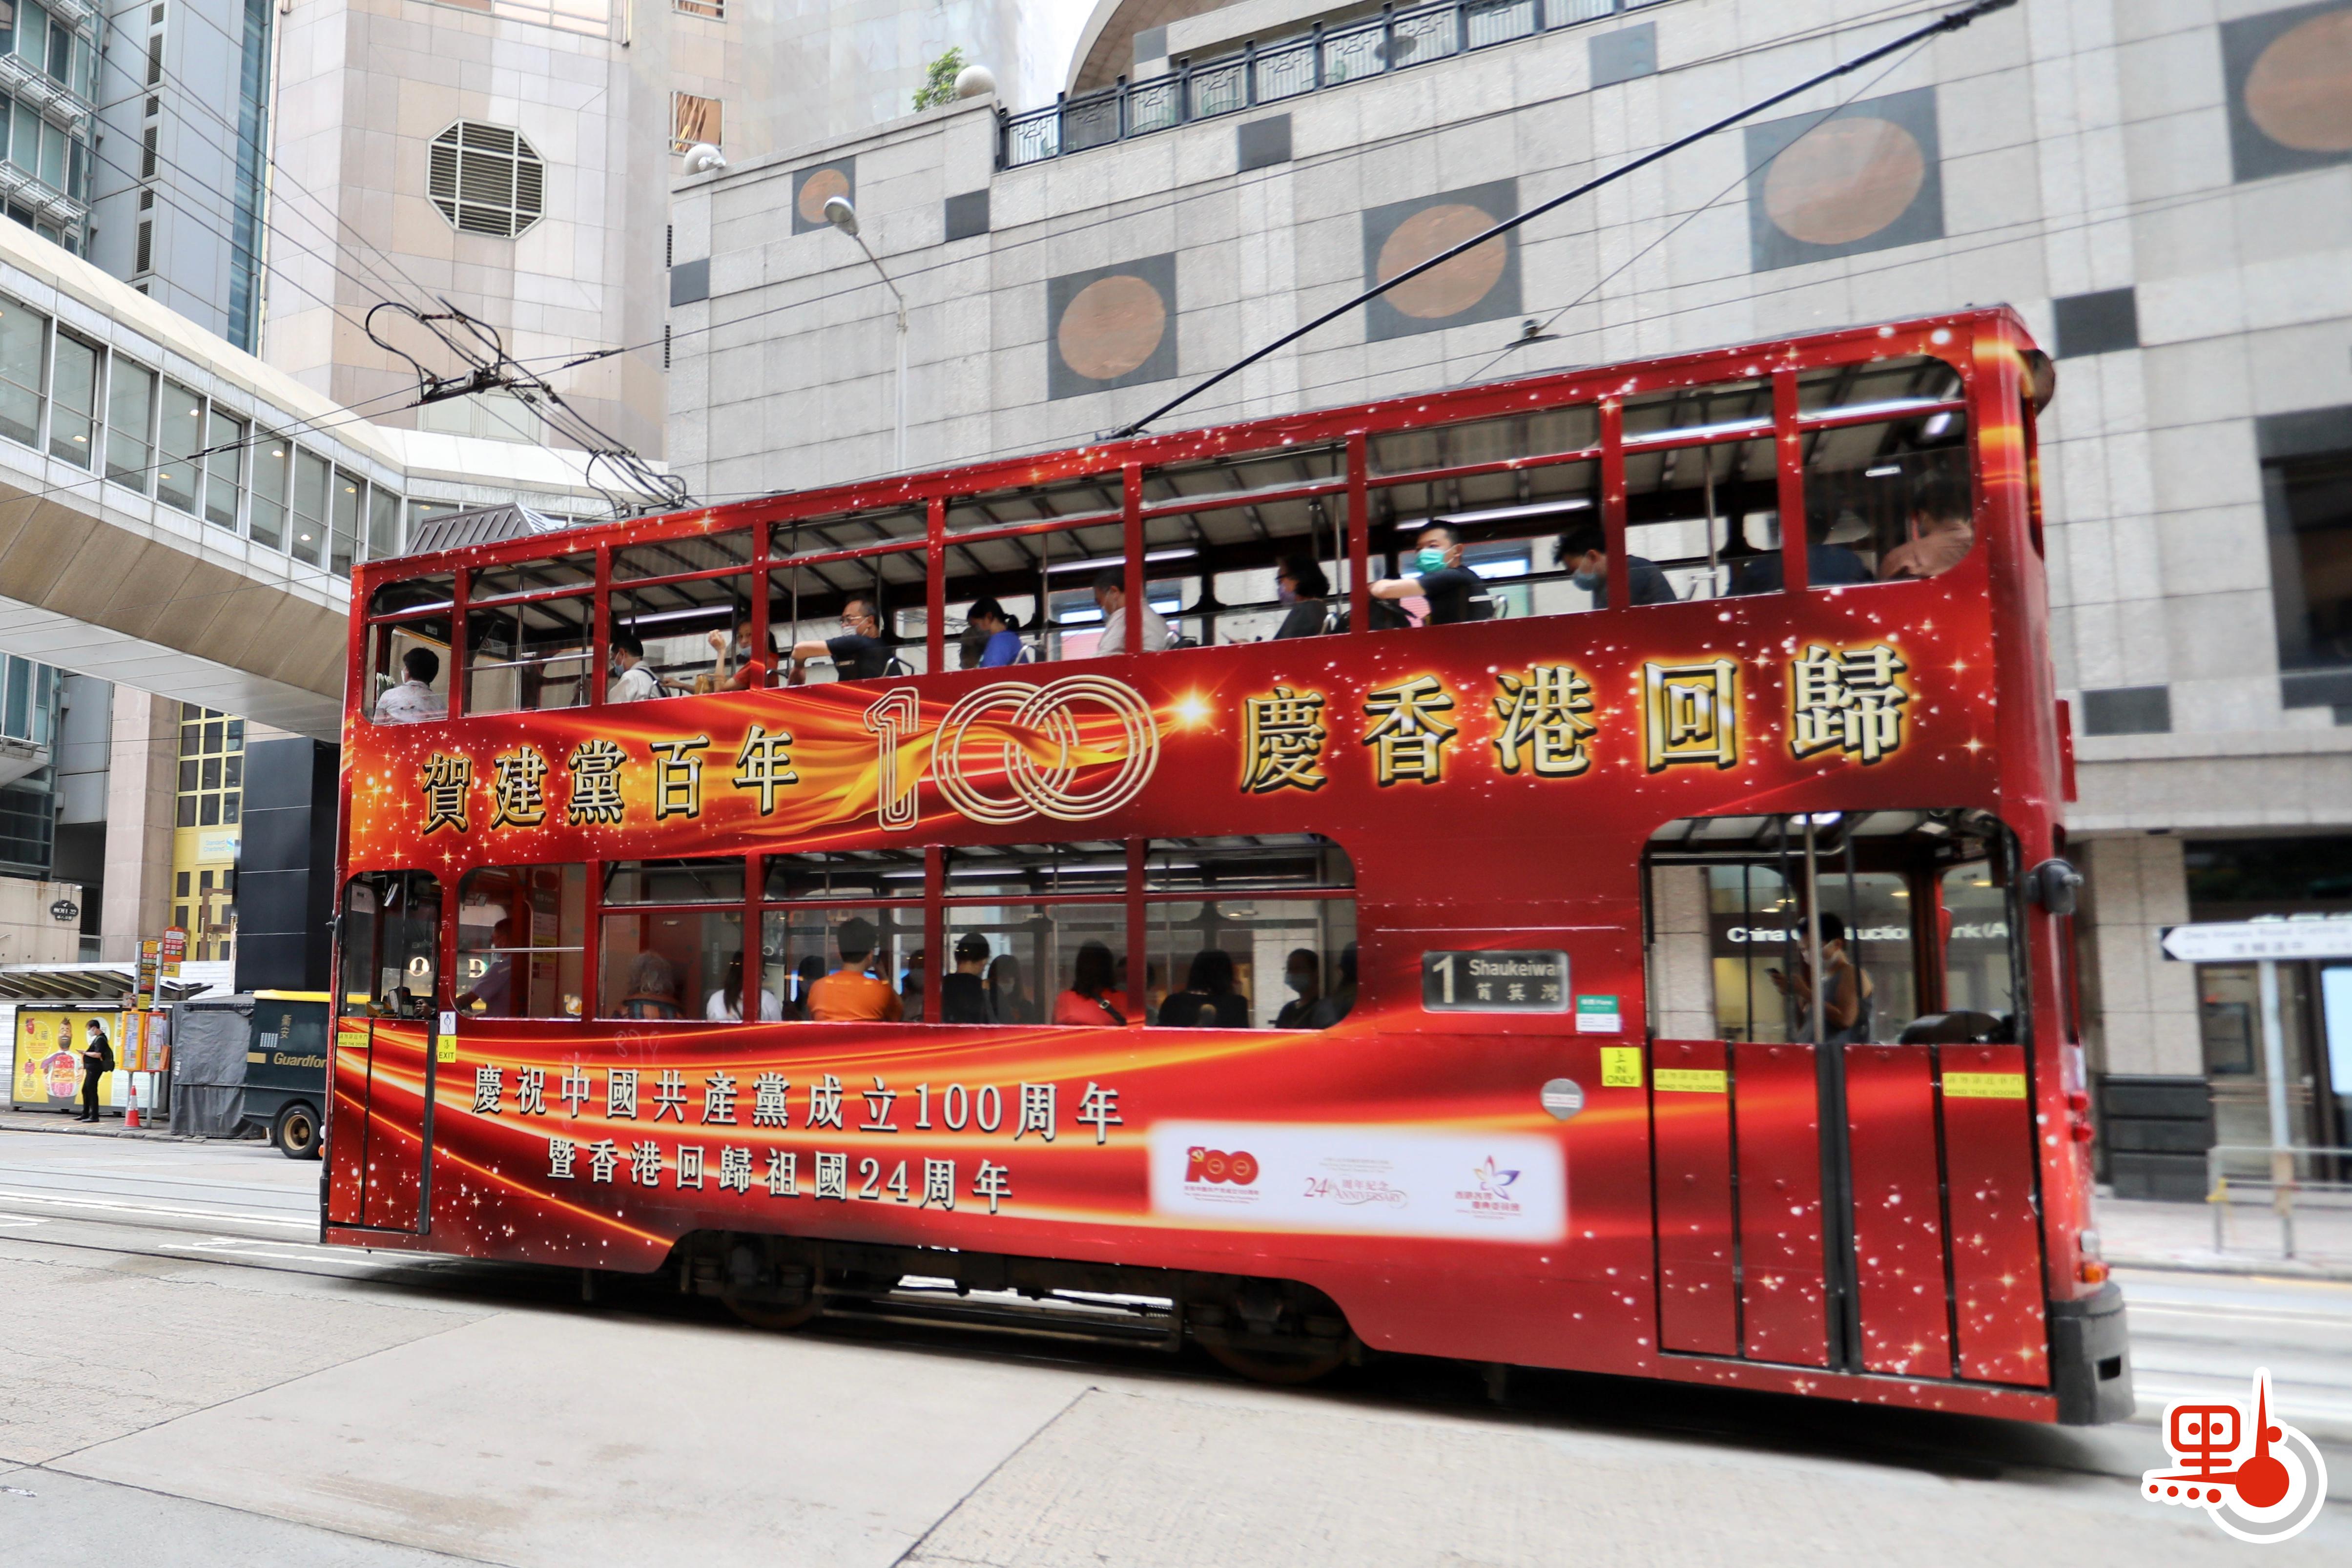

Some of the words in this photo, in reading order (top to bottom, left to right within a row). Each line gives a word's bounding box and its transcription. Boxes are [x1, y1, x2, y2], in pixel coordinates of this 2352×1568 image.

[1240, 644, 1908, 793] 慶香港回歸
[424, 724, 798, 833] 賀建黨百年
[863, 675, 1159, 832] 100
[1432, 955, 1454, 1004] 1
[273, 1052, 327, 1068] Guardfor
[1606, 1075, 1635, 1084] ONLY
[1615, 1050, 1626, 1063] 上
[472, 1064, 1122, 1144] 慶祝中國共產黨成立100周年
[547, 1136, 1011, 1214] 暨香港回歸祖國24周年
[1185, 1146, 1259, 1186] 100
